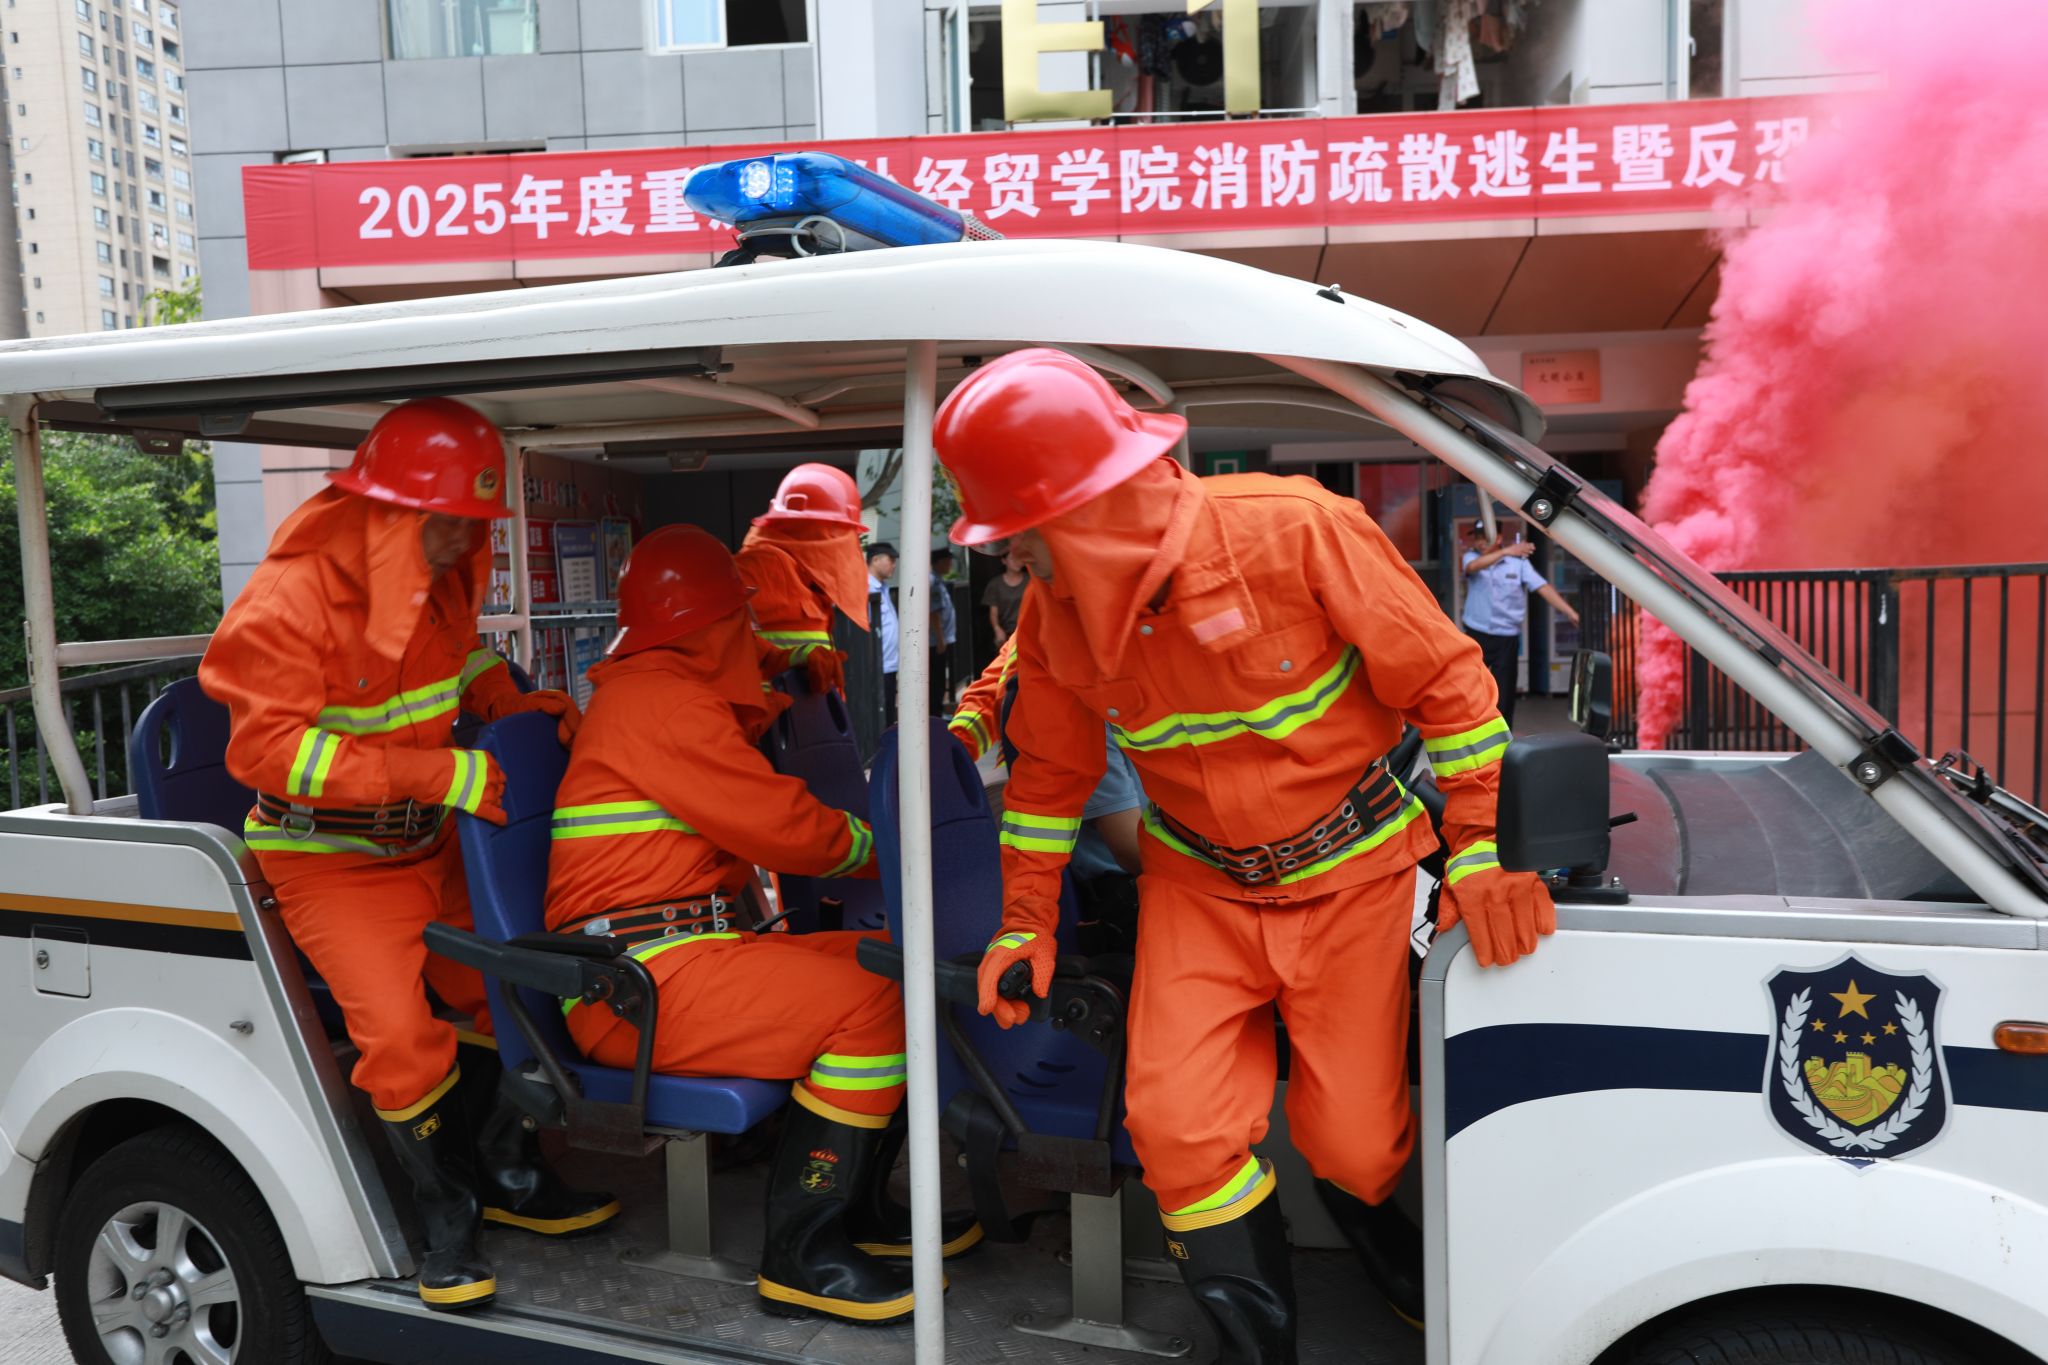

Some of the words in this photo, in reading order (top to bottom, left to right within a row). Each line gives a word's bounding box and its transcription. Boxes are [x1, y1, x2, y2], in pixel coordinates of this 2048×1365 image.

[358, 116, 1809, 240] 2025年度重经贸学院消防疏散逃生暨反恐
